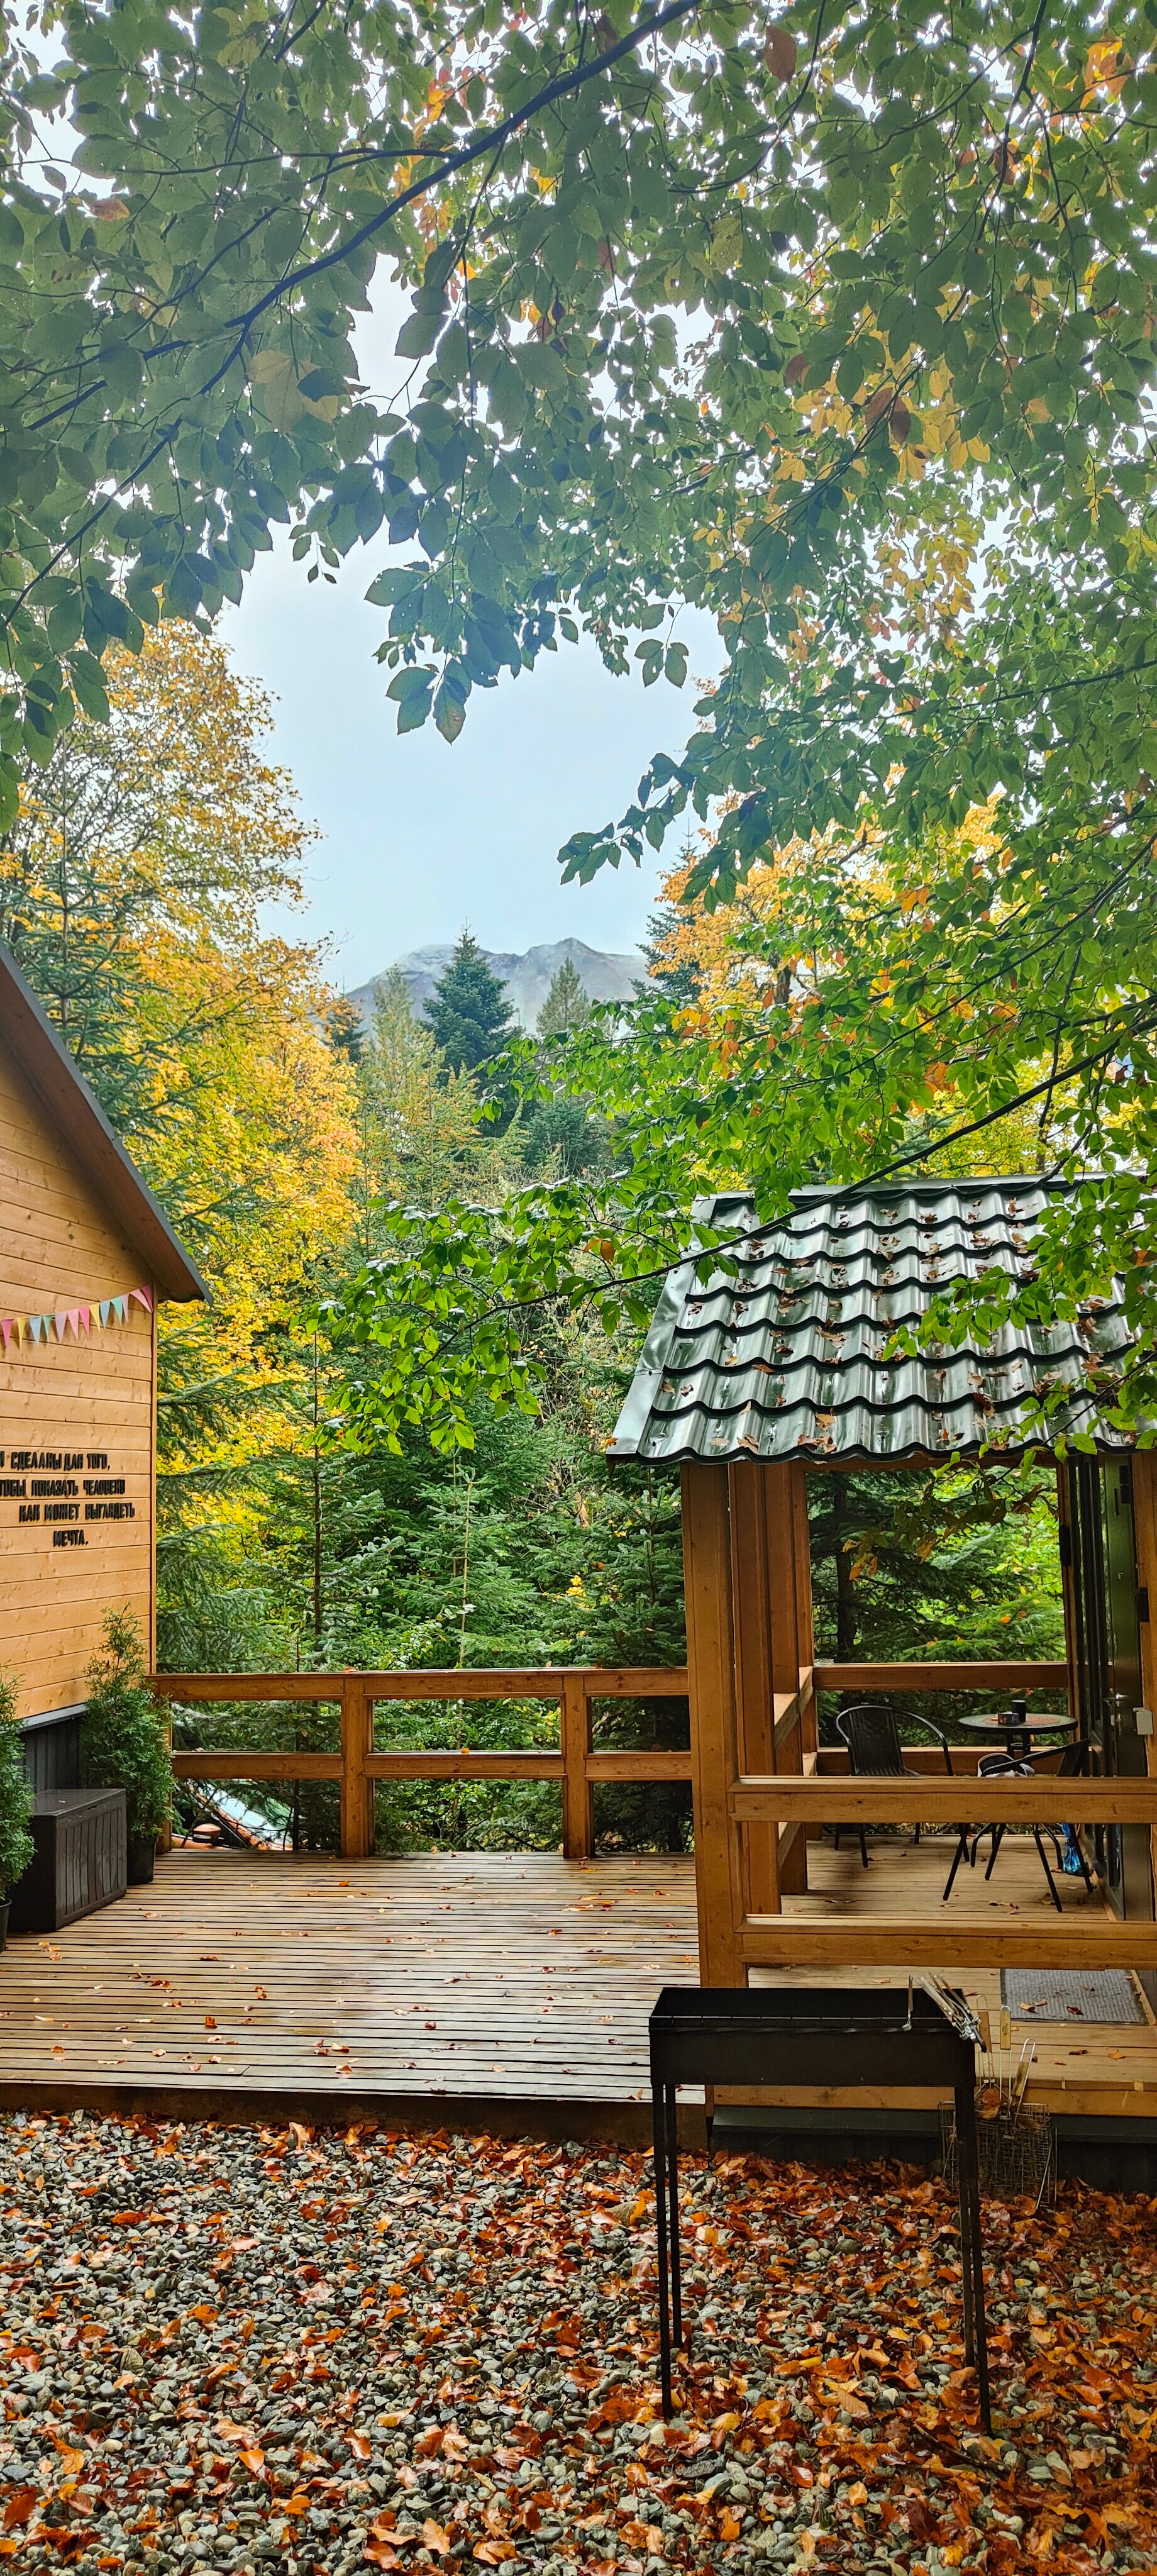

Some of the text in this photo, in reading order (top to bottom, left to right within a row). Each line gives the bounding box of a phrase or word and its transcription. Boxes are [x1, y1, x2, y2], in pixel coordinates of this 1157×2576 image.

[11, 1452, 62, 1470] СДЕЛАНЫ
[64, 1453, 83, 1471] ДЛЯ
[87, 1453, 110, 1470] ТОГО,
[31, 1480, 79, 1496] ПОКАЗАТЬ
[83, 1479, 125, 1496] ЧЕЛОВЕКУ
[19, 1502, 135, 1523] КАК МОЖЕТ ВЫГЛЯДЕТЬ
[53, 1530, 89, 1547] МЕЧТА.
